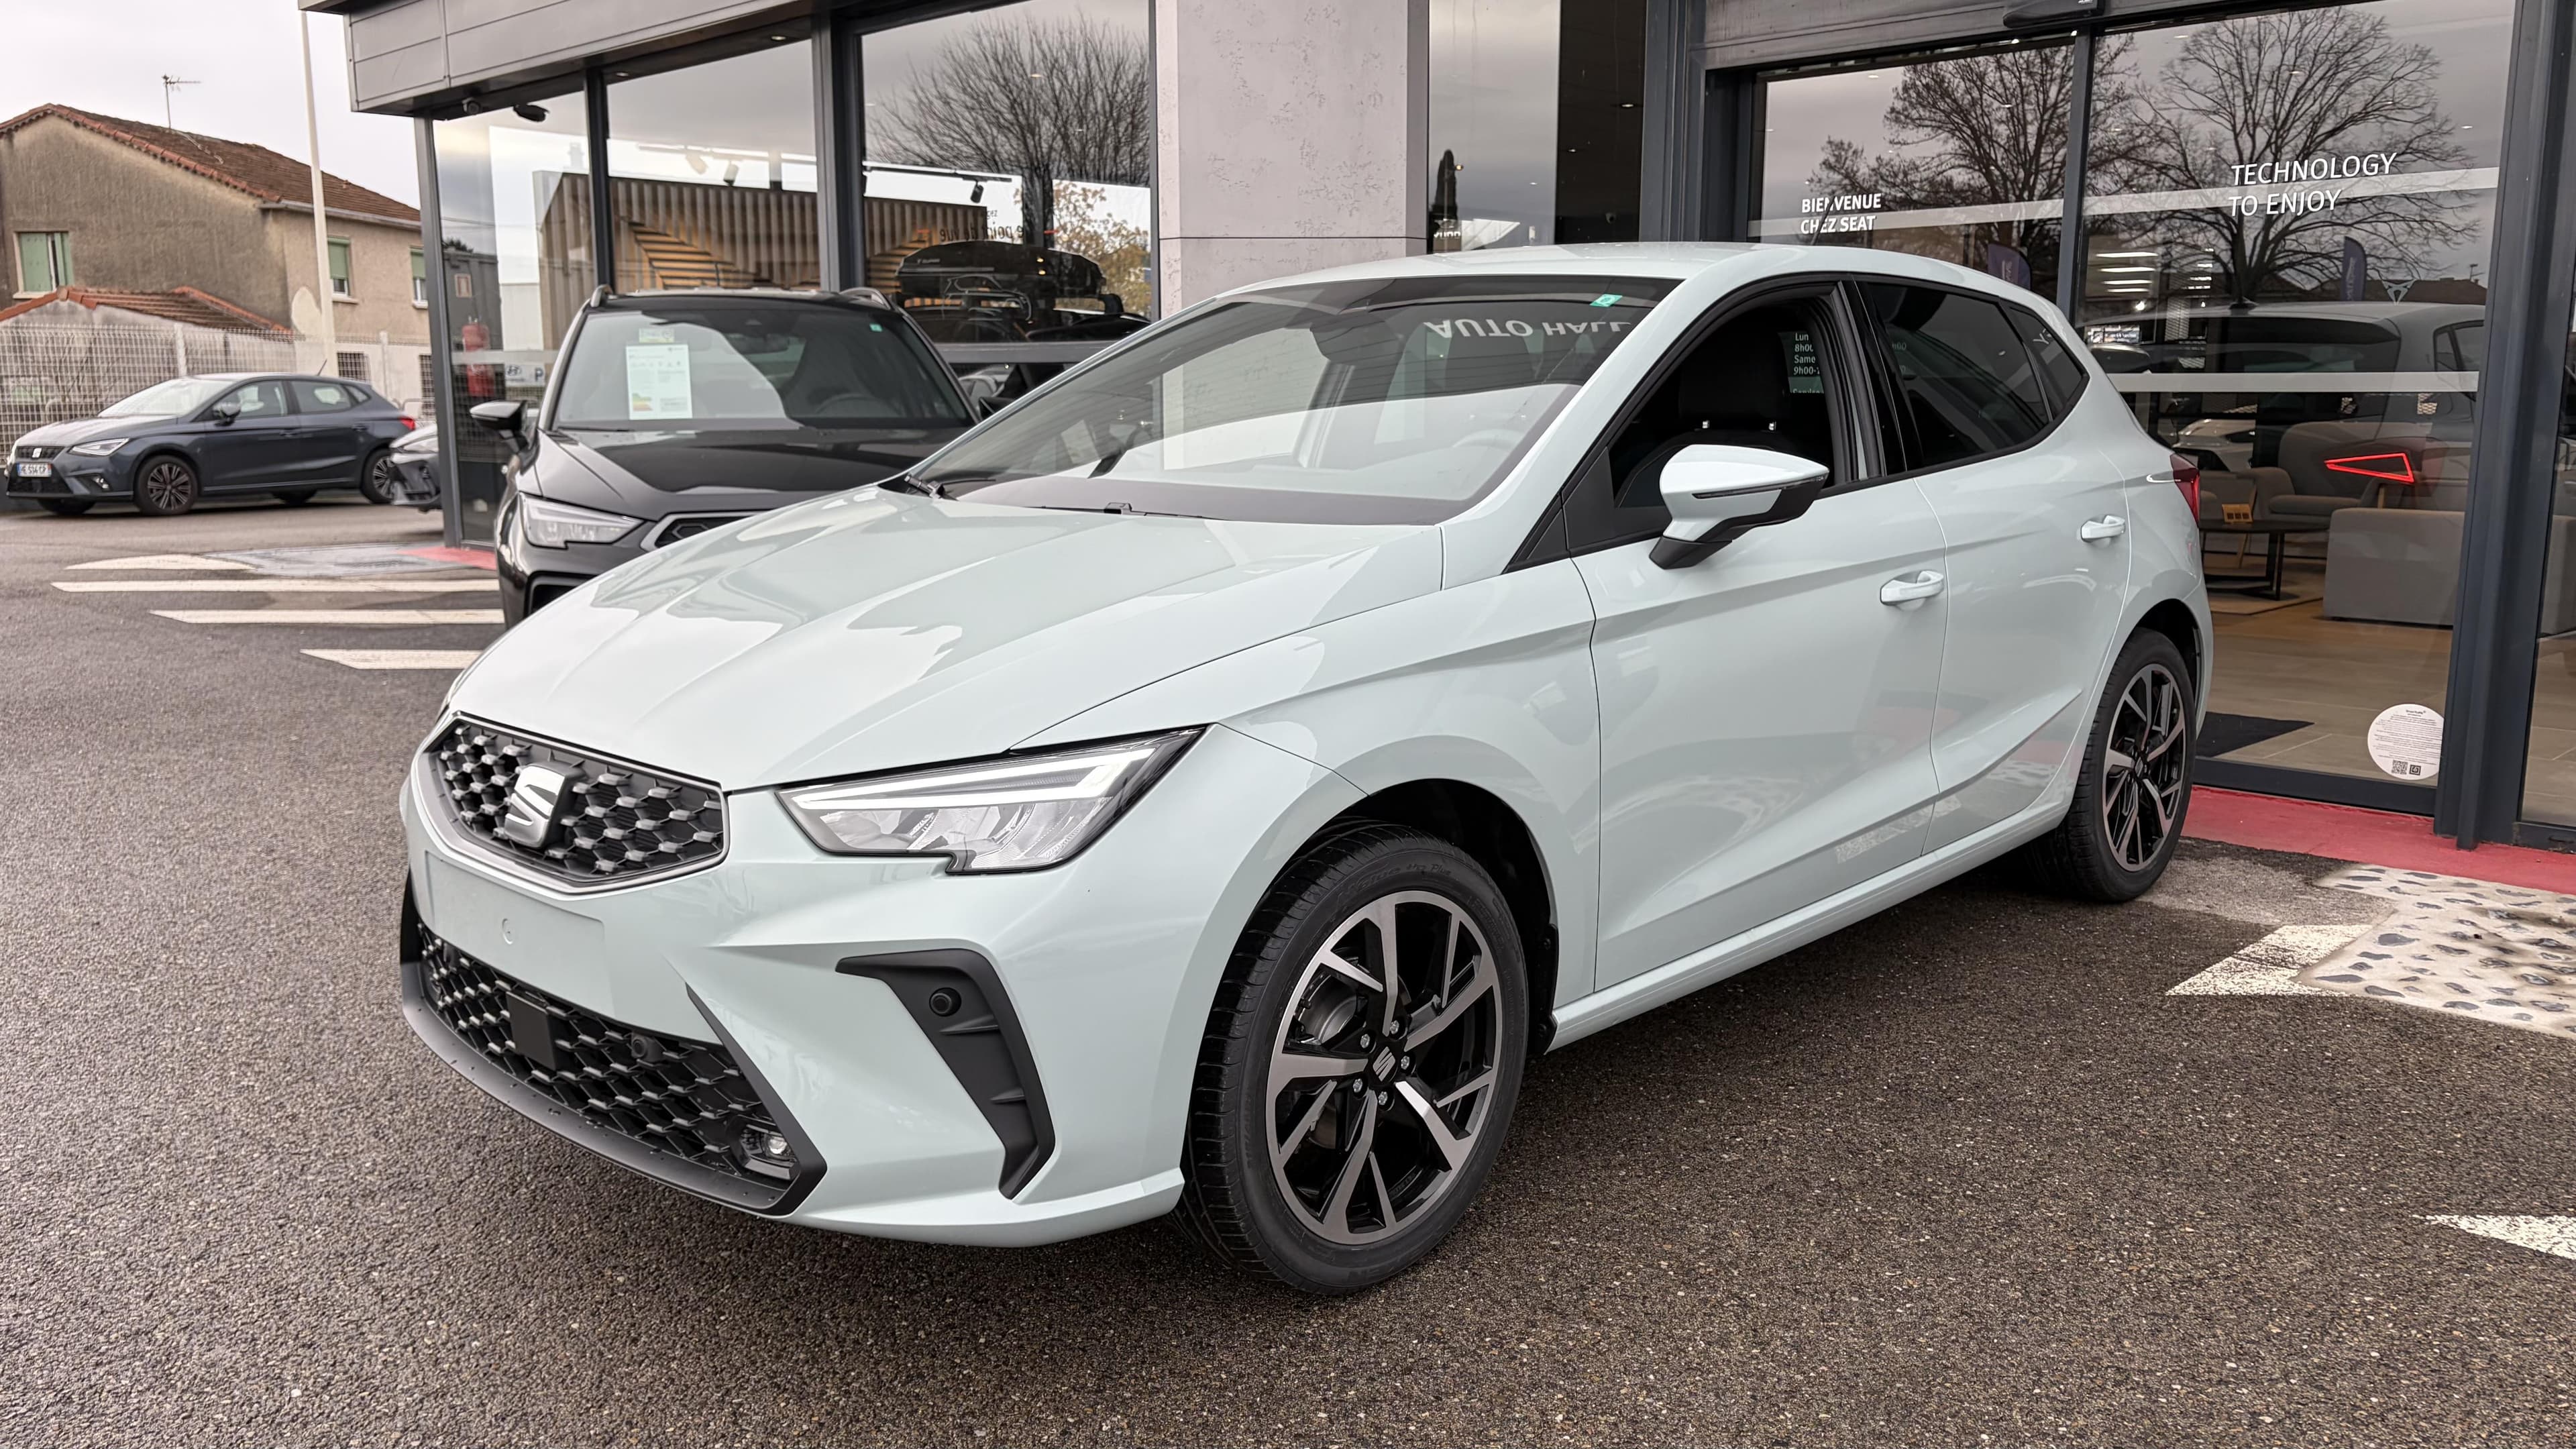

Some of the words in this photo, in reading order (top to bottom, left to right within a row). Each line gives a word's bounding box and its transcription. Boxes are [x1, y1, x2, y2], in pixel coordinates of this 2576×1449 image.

[2231, 152, 2397, 186] TECHNOLOGY
[1801, 193, 1882, 213] BIENVENUE
[2228, 195, 2258, 217] TO
[2266, 189, 2343, 216] ENJOY
[1801, 217, 1837, 234] CHEZ
[1839, 215, 1876, 232] SEAT
